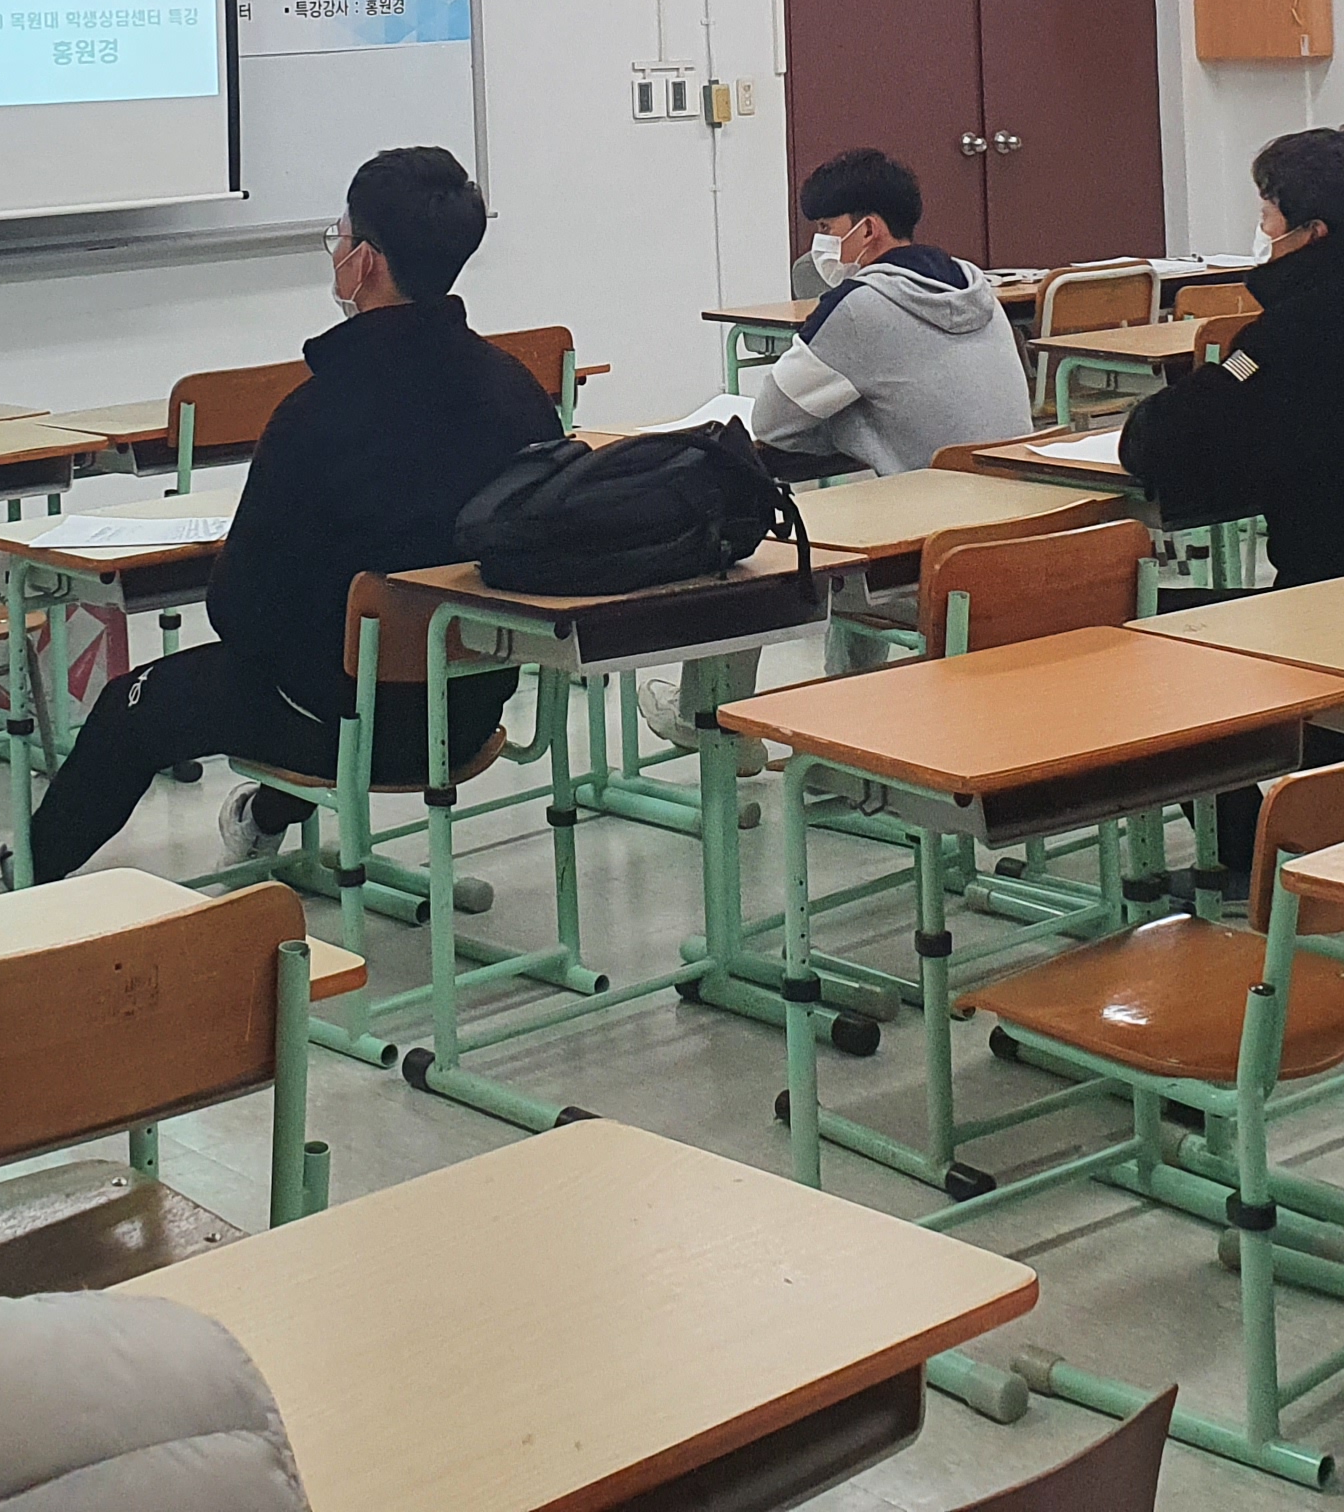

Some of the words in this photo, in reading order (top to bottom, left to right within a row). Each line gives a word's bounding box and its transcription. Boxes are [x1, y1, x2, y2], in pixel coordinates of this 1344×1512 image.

[10, 11, 59, 31] 목원대
[65, 8, 162, 29] 학생상담센터
[168, 7, 199, 26] 특강
[294, 0, 349, 19] 특강강사
[52, 38, 119, 66] 홍원경
